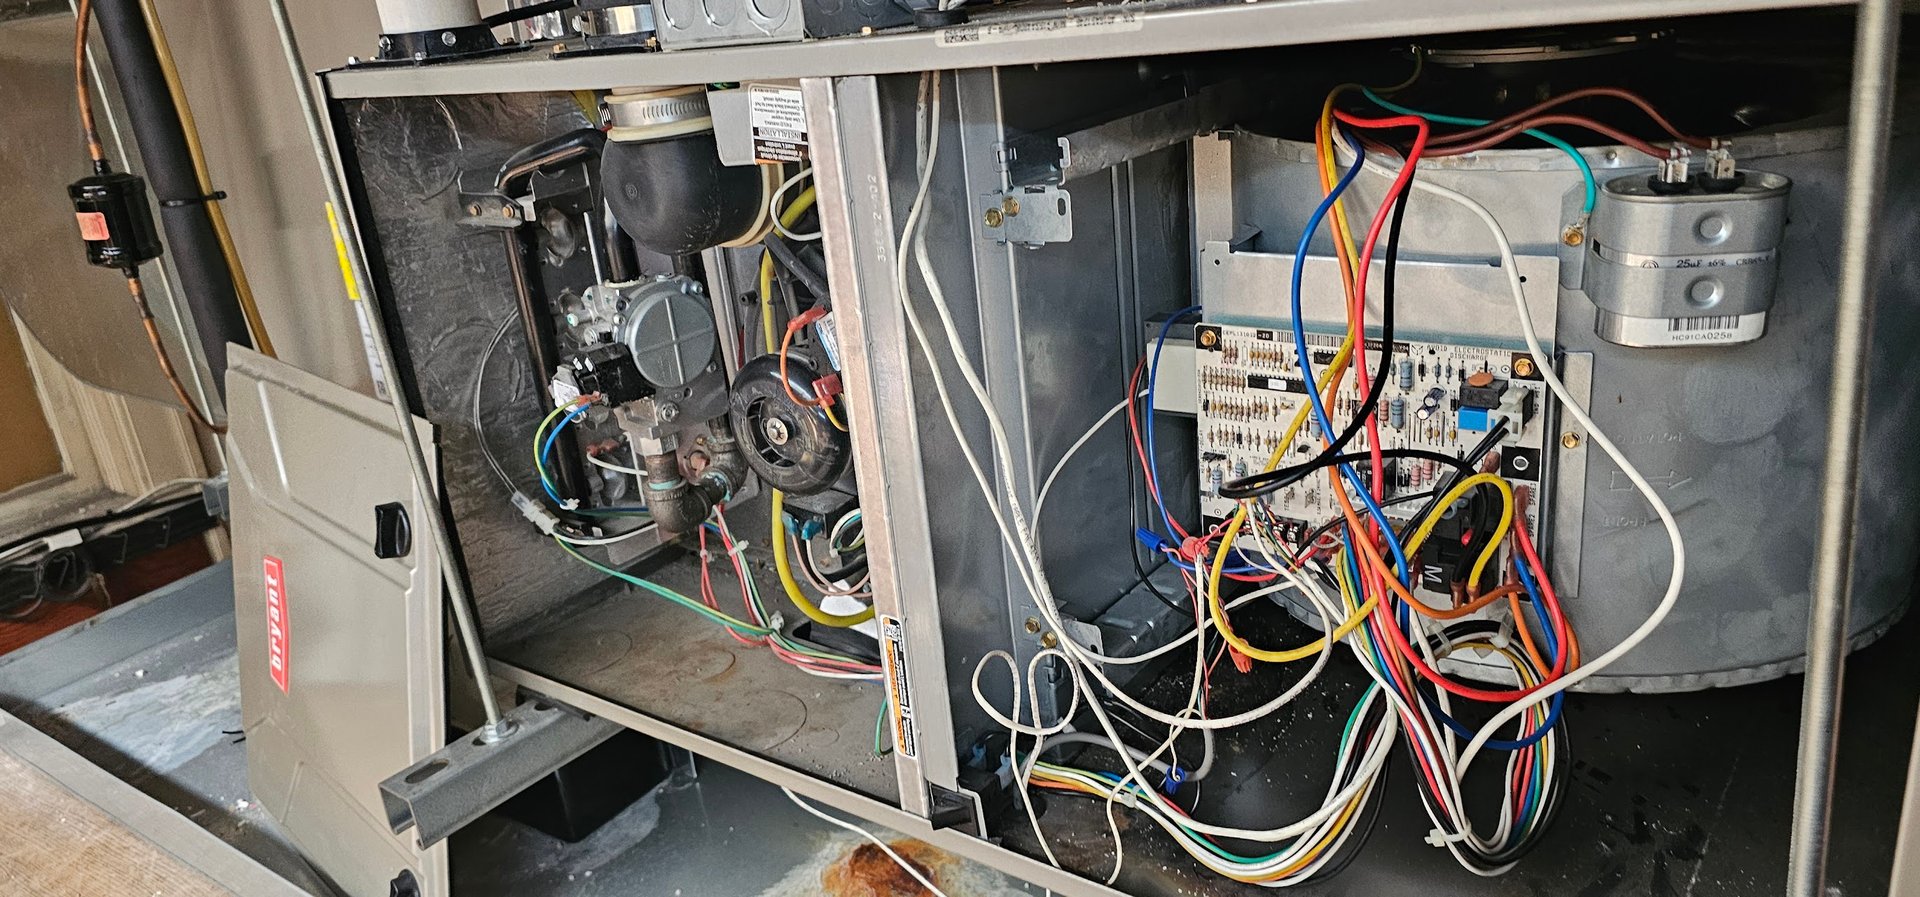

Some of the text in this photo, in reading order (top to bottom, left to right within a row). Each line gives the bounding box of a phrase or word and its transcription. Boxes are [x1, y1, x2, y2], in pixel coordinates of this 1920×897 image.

[760, 128, 800, 139] INSTALLATION
[1454, 346, 1511, 357] ELECTROSTATIC
[267, 574, 282, 671] bryant
